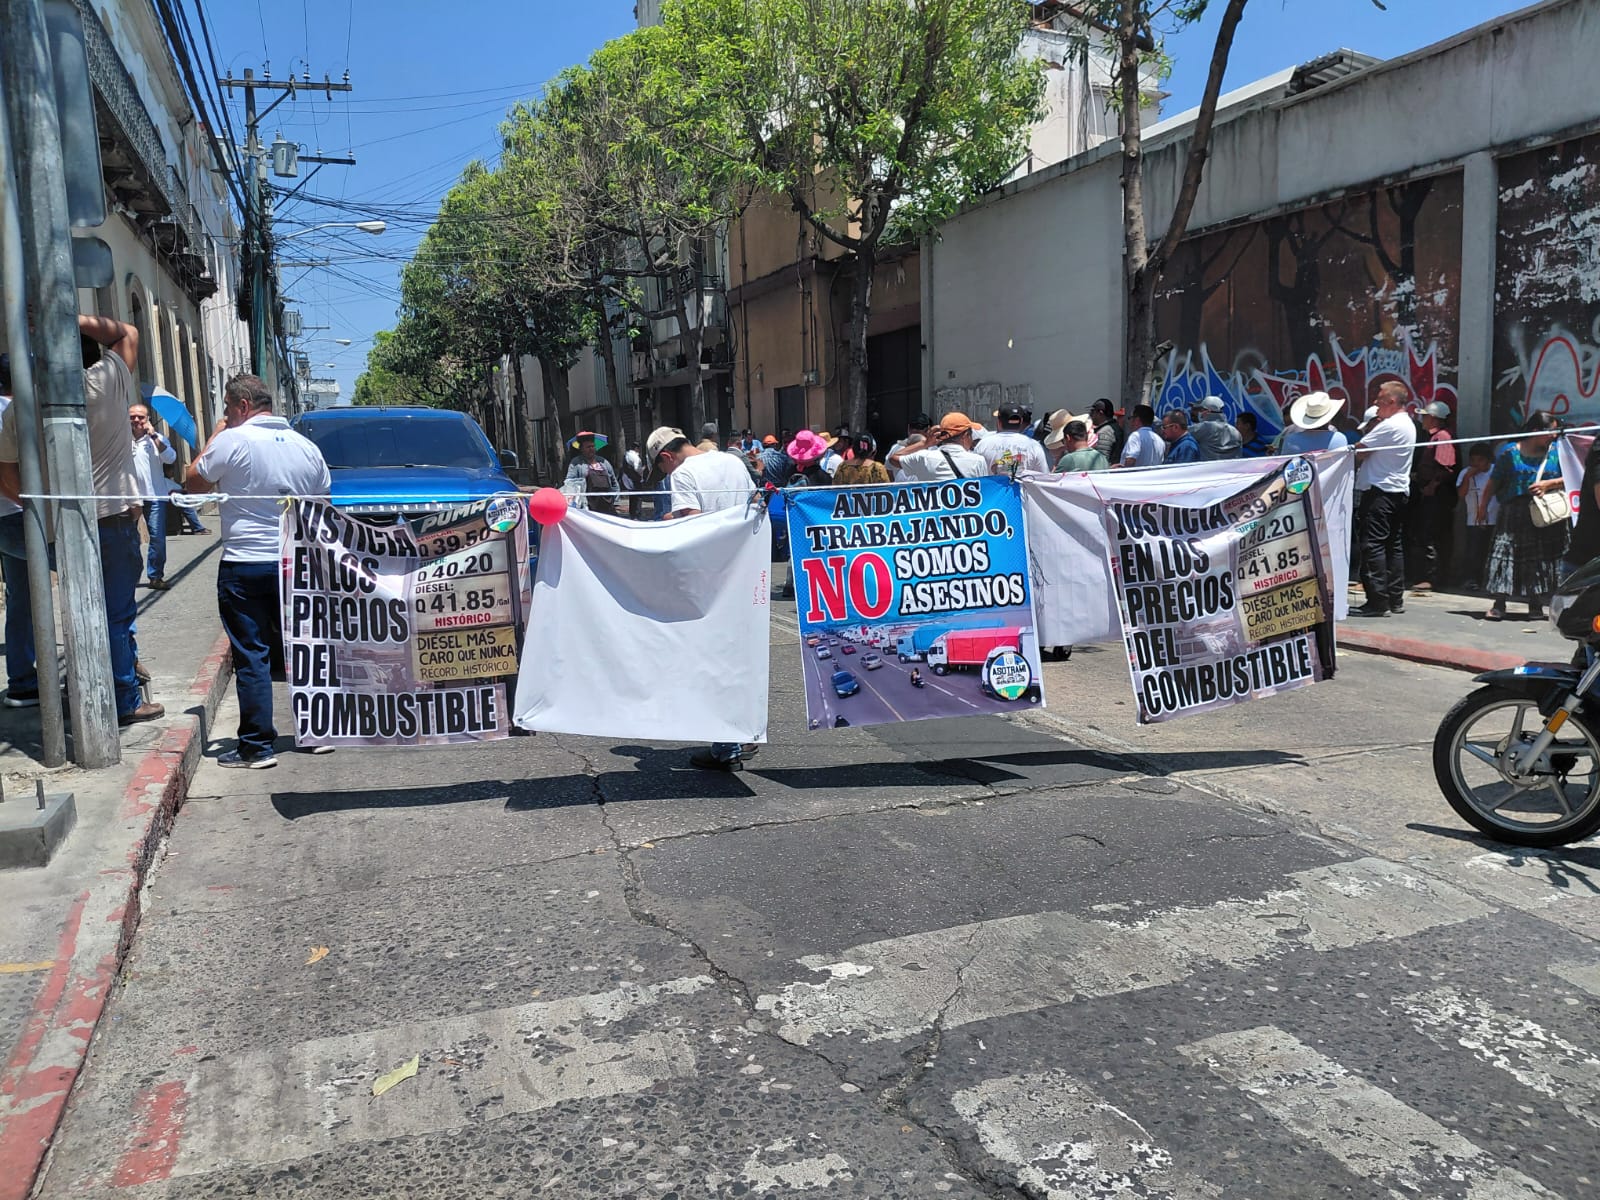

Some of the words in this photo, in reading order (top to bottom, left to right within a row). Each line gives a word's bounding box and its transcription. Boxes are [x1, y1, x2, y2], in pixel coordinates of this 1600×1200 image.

[345, 503, 453, 513] MITSUBISHI
[421, 500, 486, 533] PUMA
[832, 481, 981, 519] ANDAMOS
[294, 500, 418, 558] JUSTICIA
[807, 511, 1013, 552] TRABAJANDO,
[1114, 504, 1230, 540] JUSTICIA
[1249, 515, 1294, 544] 40.20
[432, 526, 491, 556] 39.50
[294, 547, 324, 591] EN
[330, 552, 379, 594] LOS
[432, 552, 493, 579] 40.20
[1120, 545, 1155, 584] EN
[1160, 539, 1209, 579] LOS
[1237, 567, 1245, 580] Q
[1248, 547, 1299, 577] 41.85
[803, 552, 893, 623] NO
[895, 541, 988, 580] SOMOS
[899, 575, 1024, 615] ASESINOS
[1253, 569, 1298, 590] HISTÓRICO
[416, 598, 426, 614] Q
[430, 588, 496, 613] 41.85
[1124, 571, 1234, 627] PRECIOS
[1242, 595, 1278, 614] DIÉSEL
[1280, 586, 1304, 603] MÁS
[1247, 609, 1272, 627] CARO
[1275, 604, 1289, 617] QUE
[1292, 596, 1320, 612] NUNCA
[292, 596, 409, 643] PRECIOS
[435, 611, 491, 627] HISTÓRICO
[417, 632, 462, 651] DIÉSEL
[467, 629, 496, 647] MÁS
[419, 650, 454, 666] CARO
[458, 649, 477, 662] QUE
[480, 644, 515, 660] NUNCA
[1132, 627, 1181, 672] DEL
[292, 644, 341, 688] DEL
[420, 666, 458, 680] RÉCORD
[463, 661, 509, 676] HISTÓRICO
[1142, 637, 1312, 715] COMBUSTIBLE
[293, 688, 496, 738] COMBUSTIBLE
